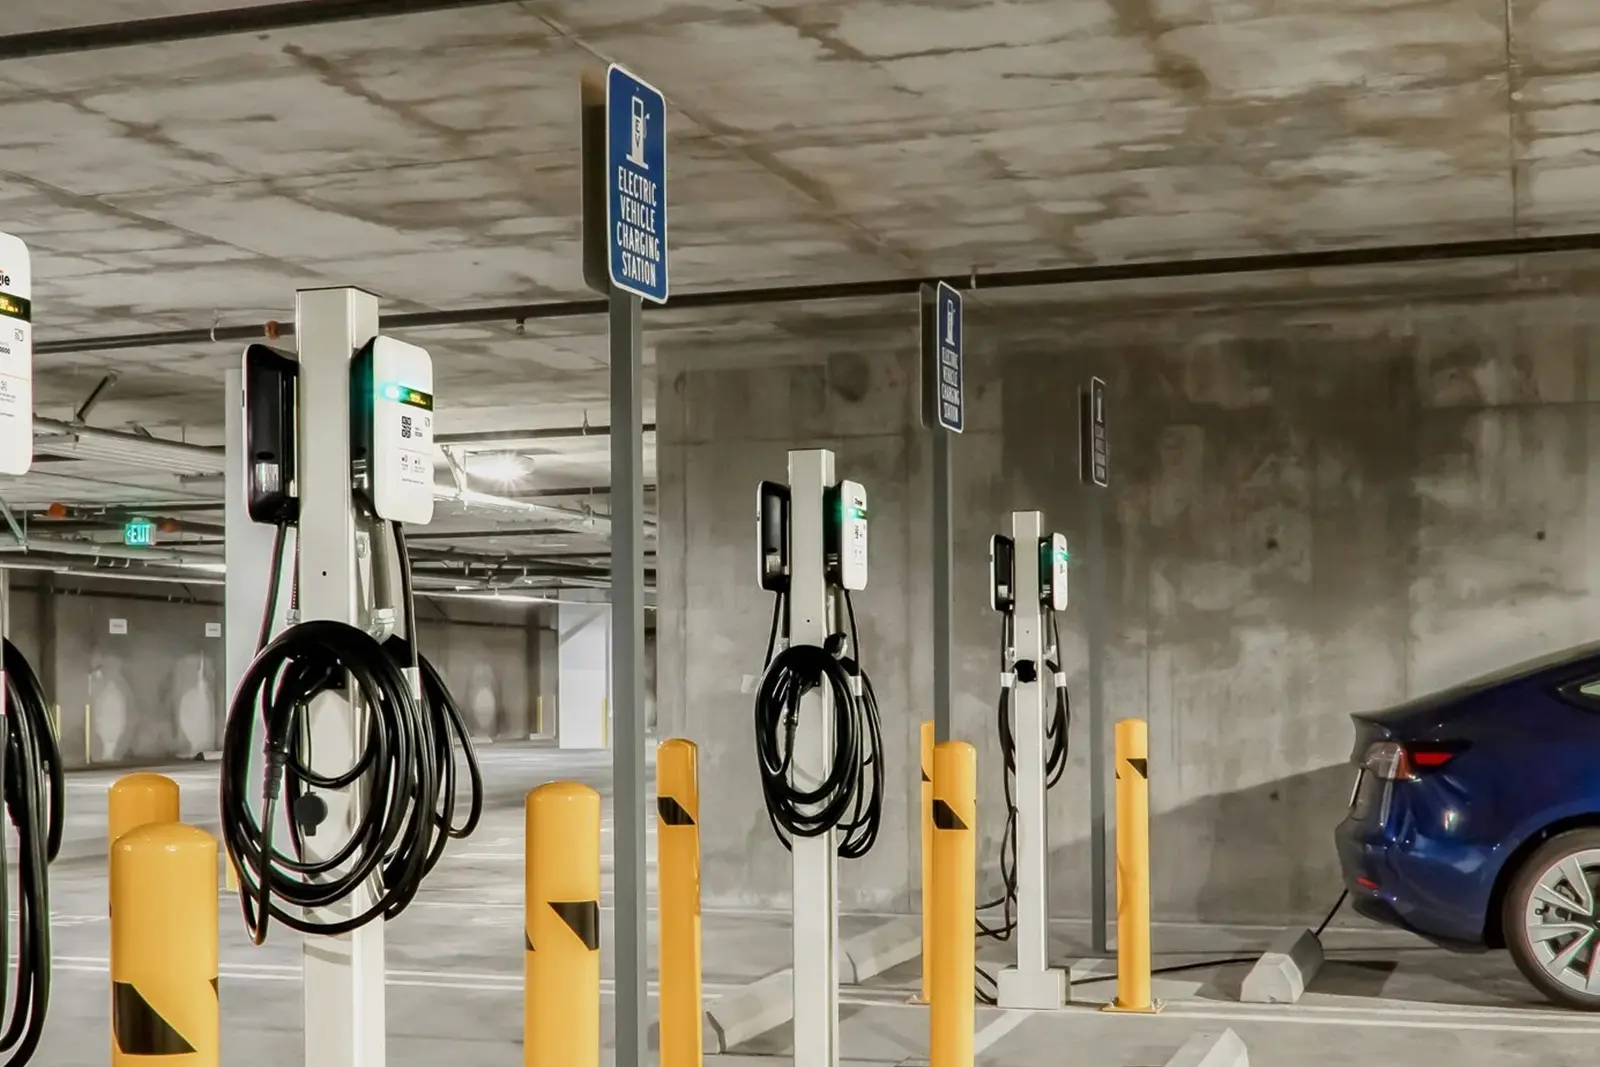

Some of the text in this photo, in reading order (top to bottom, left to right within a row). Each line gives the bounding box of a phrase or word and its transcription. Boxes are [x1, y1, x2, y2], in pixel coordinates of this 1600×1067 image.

[618, 165, 657, 207] ELECTRIC
[620, 194, 656, 233] VEHICLE
[616, 221, 660, 261] CHARGING
[622, 253, 656, 287] STATION
